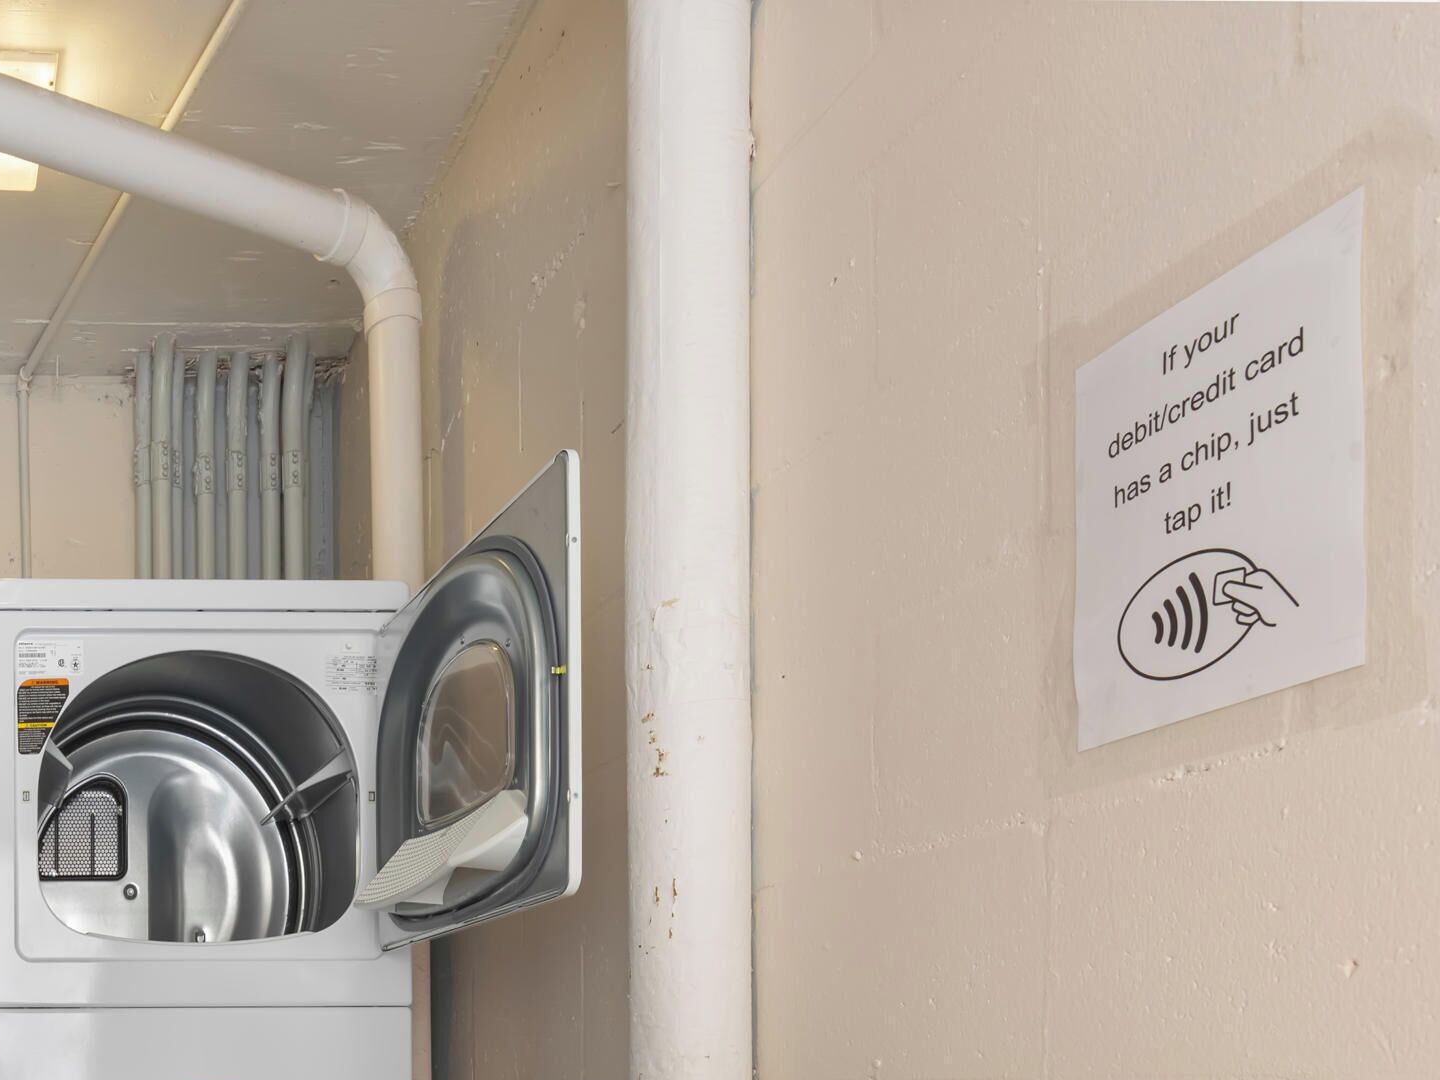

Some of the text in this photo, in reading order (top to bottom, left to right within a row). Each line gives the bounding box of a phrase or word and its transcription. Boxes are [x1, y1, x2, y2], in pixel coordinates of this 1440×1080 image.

[1162, 313, 1240, 375] If your
[1108, 326, 1304, 459] debit/credit card
[1114, 392, 1299, 508] has a chip, just
[1164, 481, 1232, 535] tap it!
